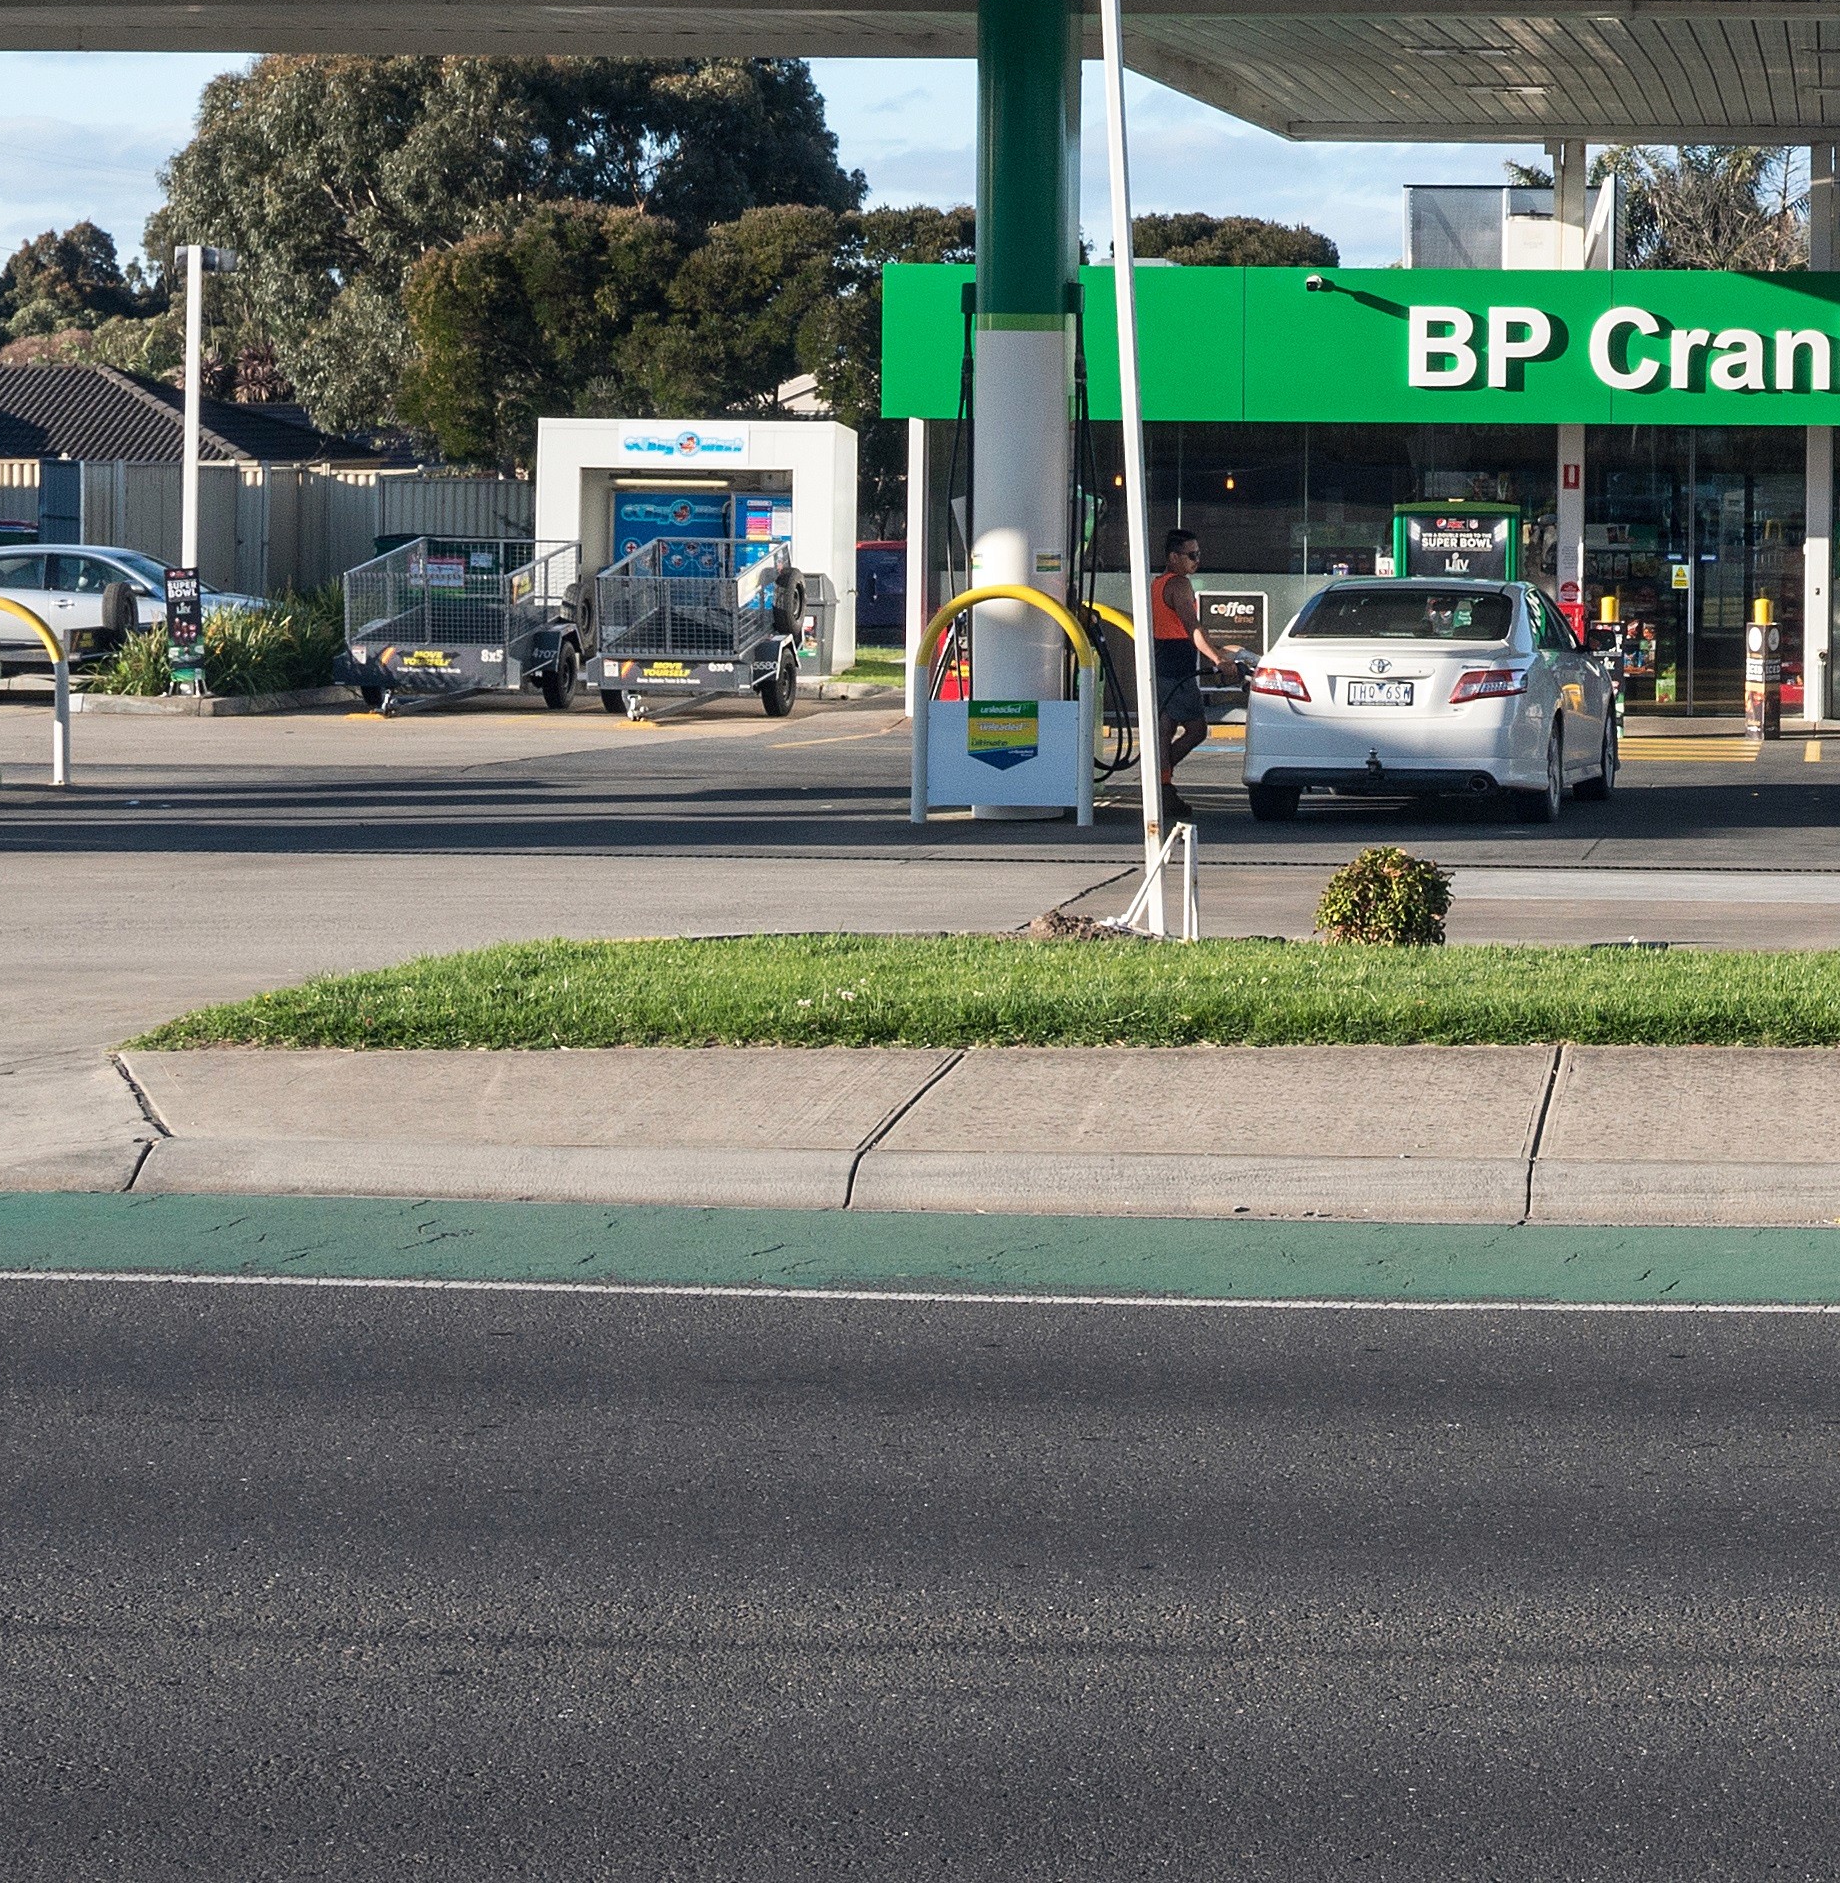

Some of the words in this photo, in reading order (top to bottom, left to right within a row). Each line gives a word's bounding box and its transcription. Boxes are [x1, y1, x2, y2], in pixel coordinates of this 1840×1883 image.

[1408, 305, 1552, 389] BP
[1421, 538, 1459, 548] SUPER
[1460, 538, 1493, 548] BOWL
[167, 580, 197, 589] SUPER
[167, 588, 198, 599] BOWL
[1210, 602, 1255, 617] coffee
[413, 650, 444, 659] MOVE
[481, 649, 504, 663] 8x5
[533, 648, 557, 659] 4707
[403, 658, 453, 667] YOURSELF
[708, 662, 734, 672] 6x4
[642, 668, 691, 677] YOURSELF
[980, 705, 1021, 714] unleaded
[980, 723, 1022, 732] unleaded
